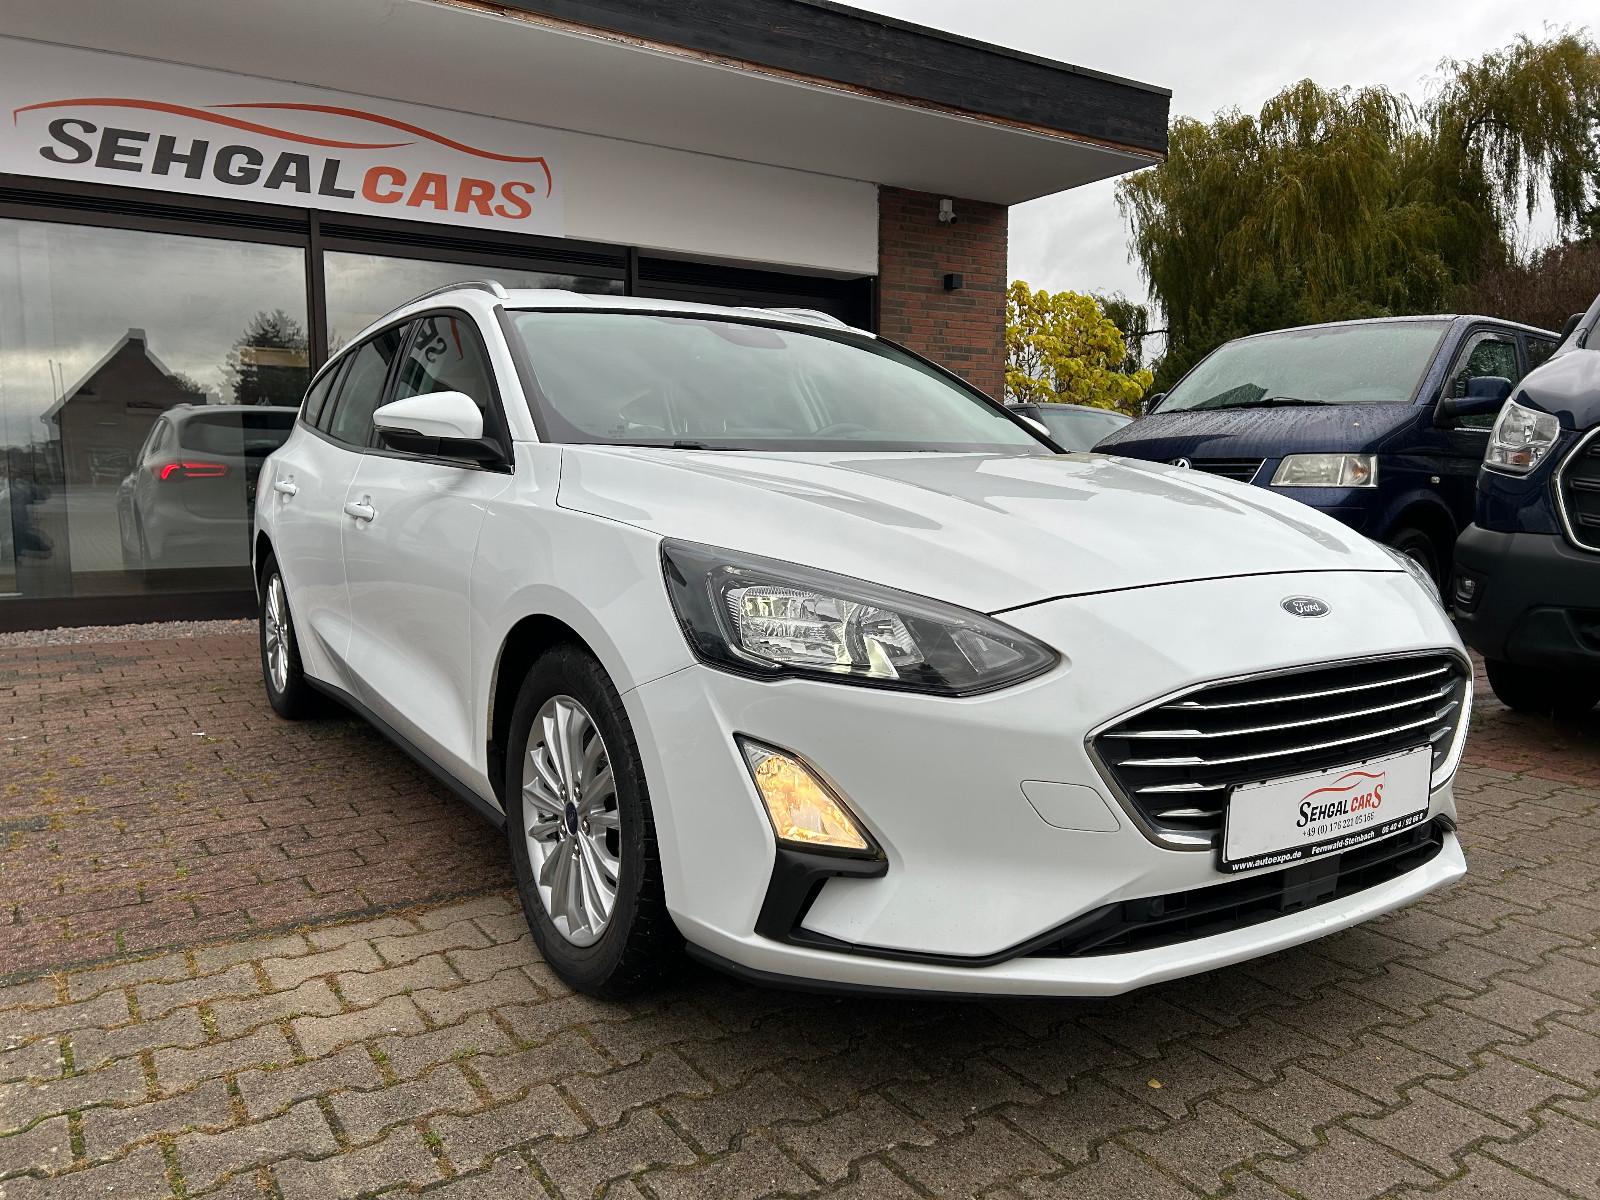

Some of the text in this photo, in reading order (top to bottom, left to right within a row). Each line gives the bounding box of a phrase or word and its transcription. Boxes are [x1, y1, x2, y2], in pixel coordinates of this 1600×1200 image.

[1292, 600, 1322, 614] Ford
[1302, 826, 1316, 838] +49
[1317, 824, 1328, 836] (0)
[1329, 821, 1342, 833] 176
[1232, 850, 1302, 871] www.autoexpo.de
[1311, 830, 1375, 855] Fernwald-Steinbach
